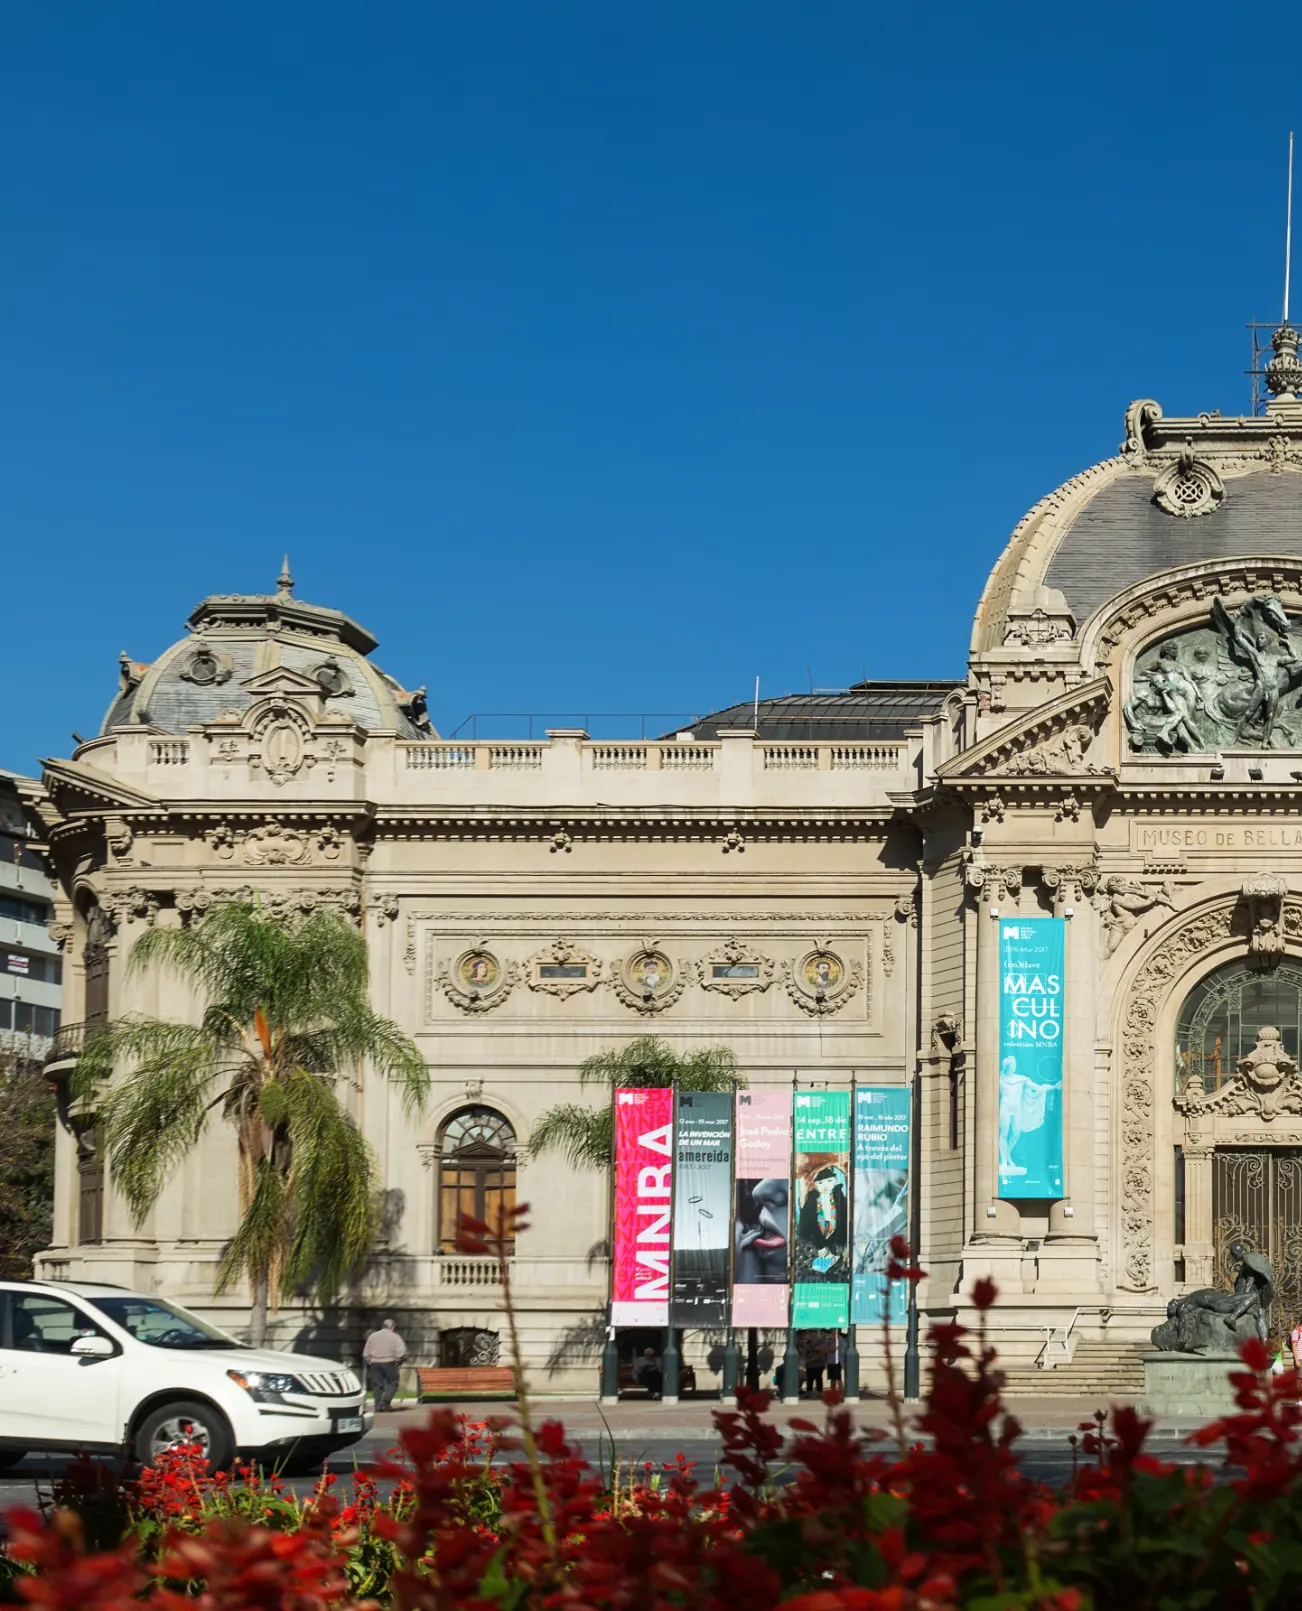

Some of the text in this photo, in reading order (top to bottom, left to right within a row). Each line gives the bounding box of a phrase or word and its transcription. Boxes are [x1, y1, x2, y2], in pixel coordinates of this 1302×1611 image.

[1143, 830, 1207, 846] MUSEO
[1004, 974, 1060, 995] MAS
[1012, 997, 1060, 1017] CUL
[1009, 1018, 1060, 1040] INO
[679, 1129, 731, 1138] LA INVENCIÓN
[740, 1126, 788, 1137] José Pedro
[796, 1128, 847, 1140] ENTRE
[857, 1124, 909, 1132] RAIMUNDO
[857, 1133, 888, 1141] RUBIO
[739, 1138, 771, 1150] Godoy
[857, 1143, 902, 1152] A través del
[679, 1149, 729, 1162] amereida
[870, 1152, 883, 1160] del
[883, 1152, 908, 1162] pintor
[634, 1122, 673, 1299] MNBA
